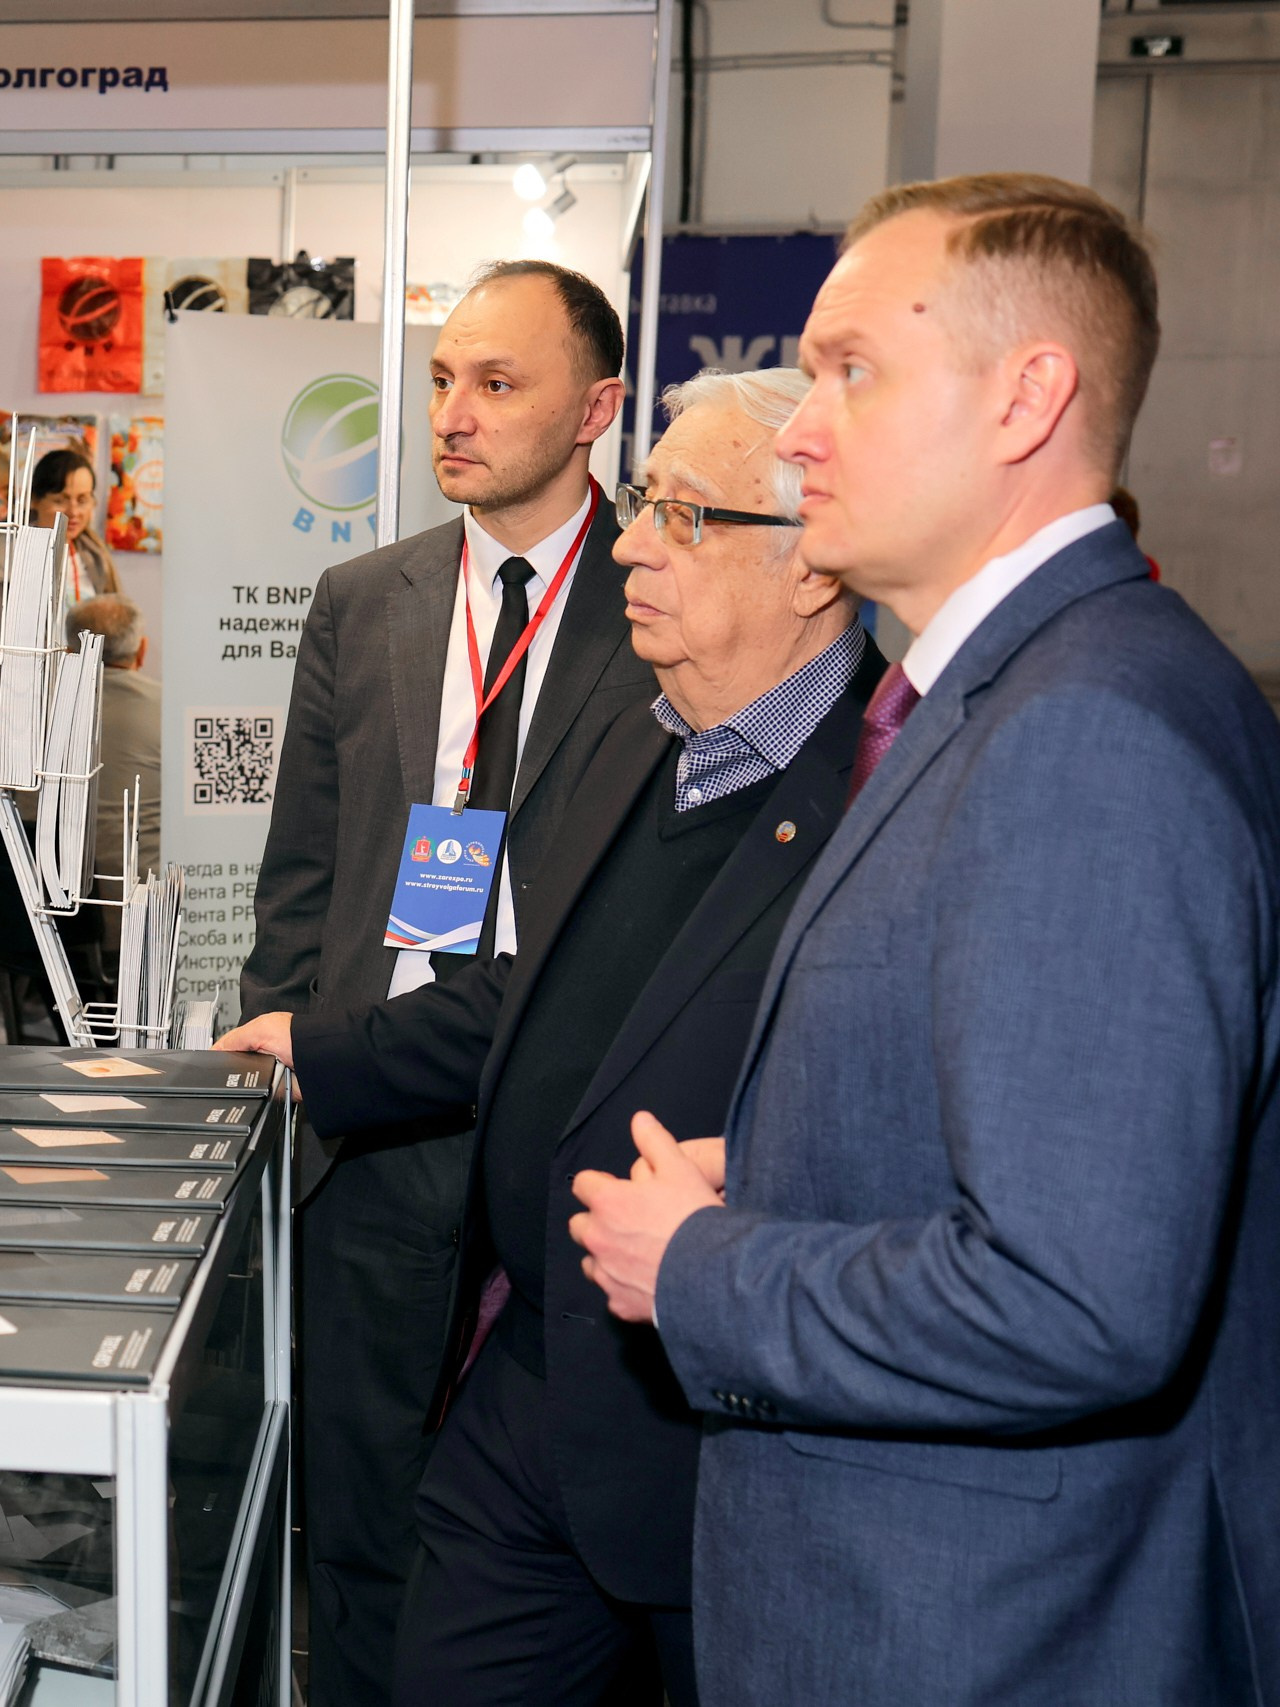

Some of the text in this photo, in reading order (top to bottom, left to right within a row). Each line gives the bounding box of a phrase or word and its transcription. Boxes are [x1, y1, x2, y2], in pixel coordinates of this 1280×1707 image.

[232, 585, 312, 605] ТК BNP
[222, 640, 297, 661] для Ва
[178, 863, 223, 877] сегда
[228, 864, 239, 876] в
[232, 882, 256, 899] PE
[178, 930, 227, 947] Скоба
[233, 933, 243, 944] и
[177, 954, 247, 972] Инструм
[177, 976, 240, 995] Стрейт
